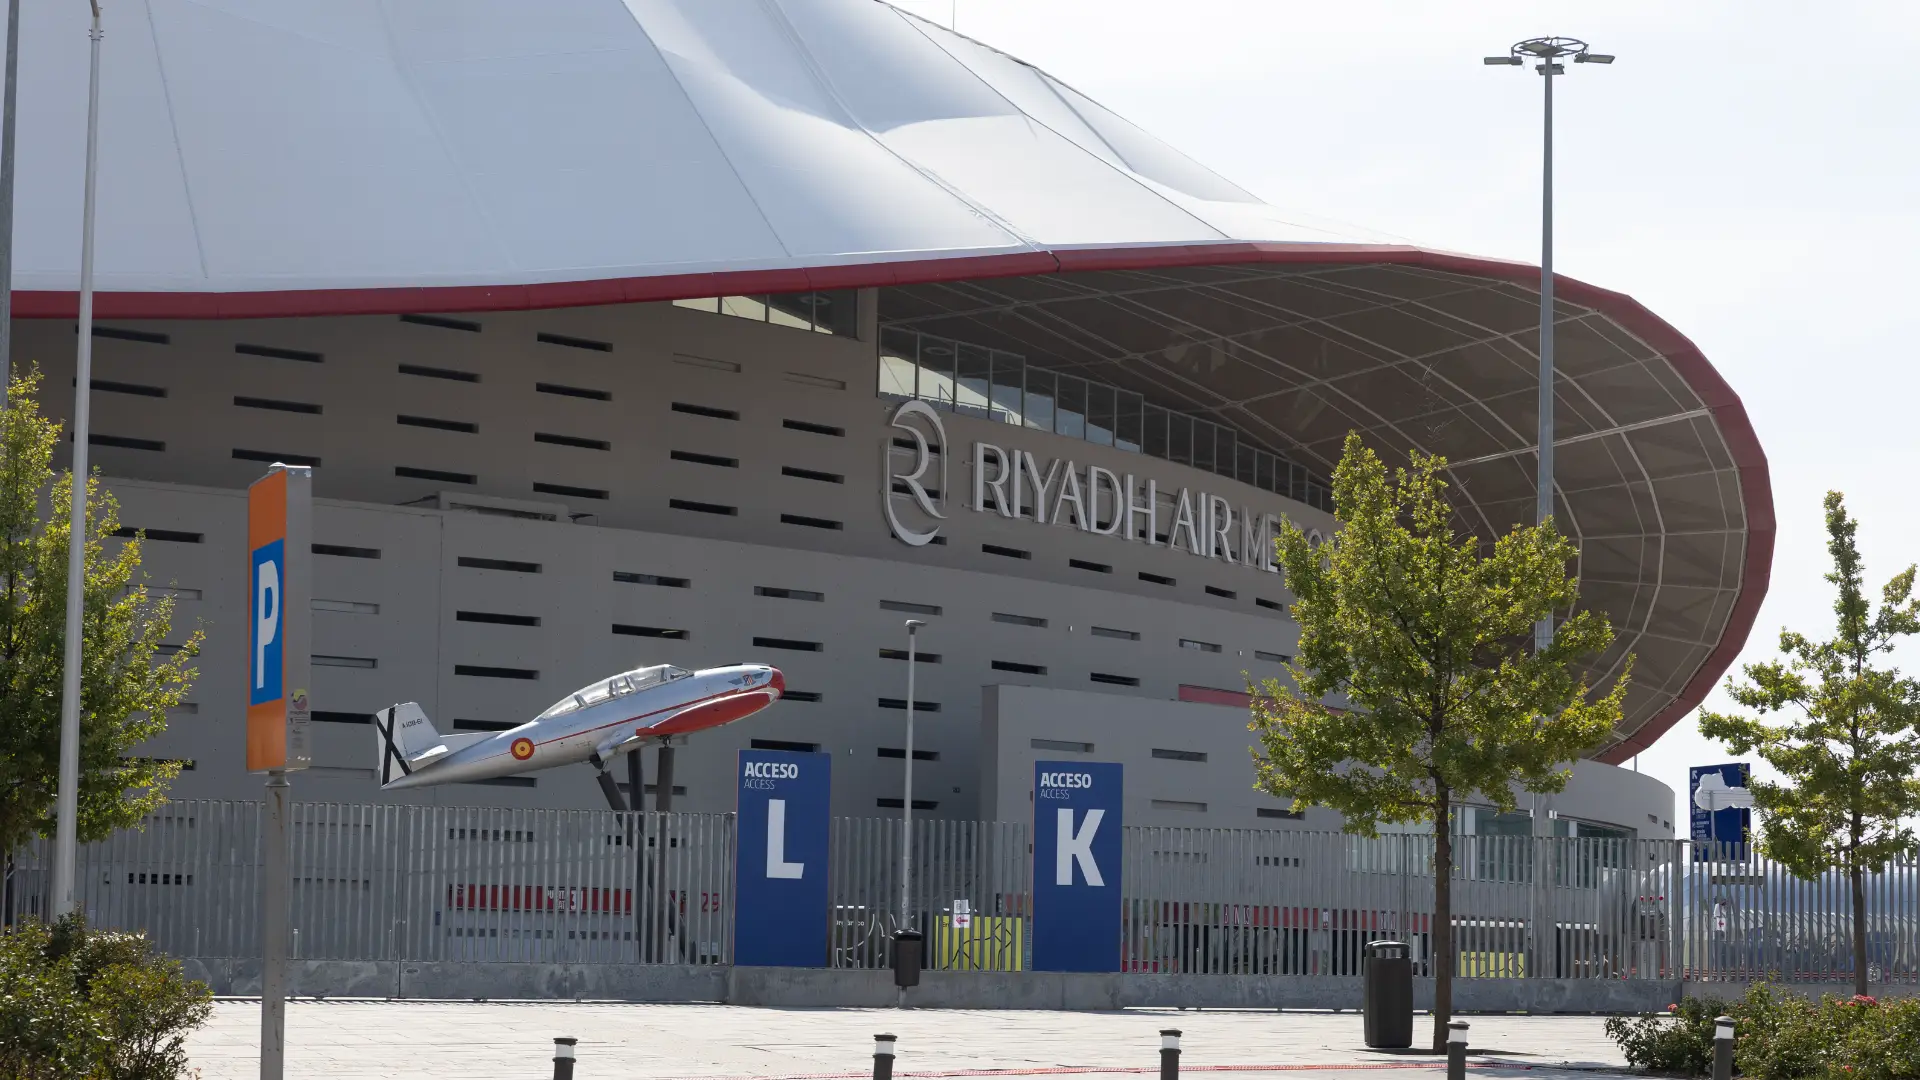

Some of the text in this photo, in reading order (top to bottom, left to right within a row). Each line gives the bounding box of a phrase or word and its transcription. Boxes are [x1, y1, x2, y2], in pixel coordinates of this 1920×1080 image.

[972, 442, 1156, 544] RIYADH
[1171, 487, 1238, 563] AIR
[257, 560, 279, 689] P
[744, 762, 798, 779] ACCESO
[744, 779, 775, 789] ACCESS
[1040, 773, 1092, 788] ACCESO
[1040, 788, 1070, 799] ACCESS
[766, 799, 804, 879] L
[1056, 808, 1105, 886] K
